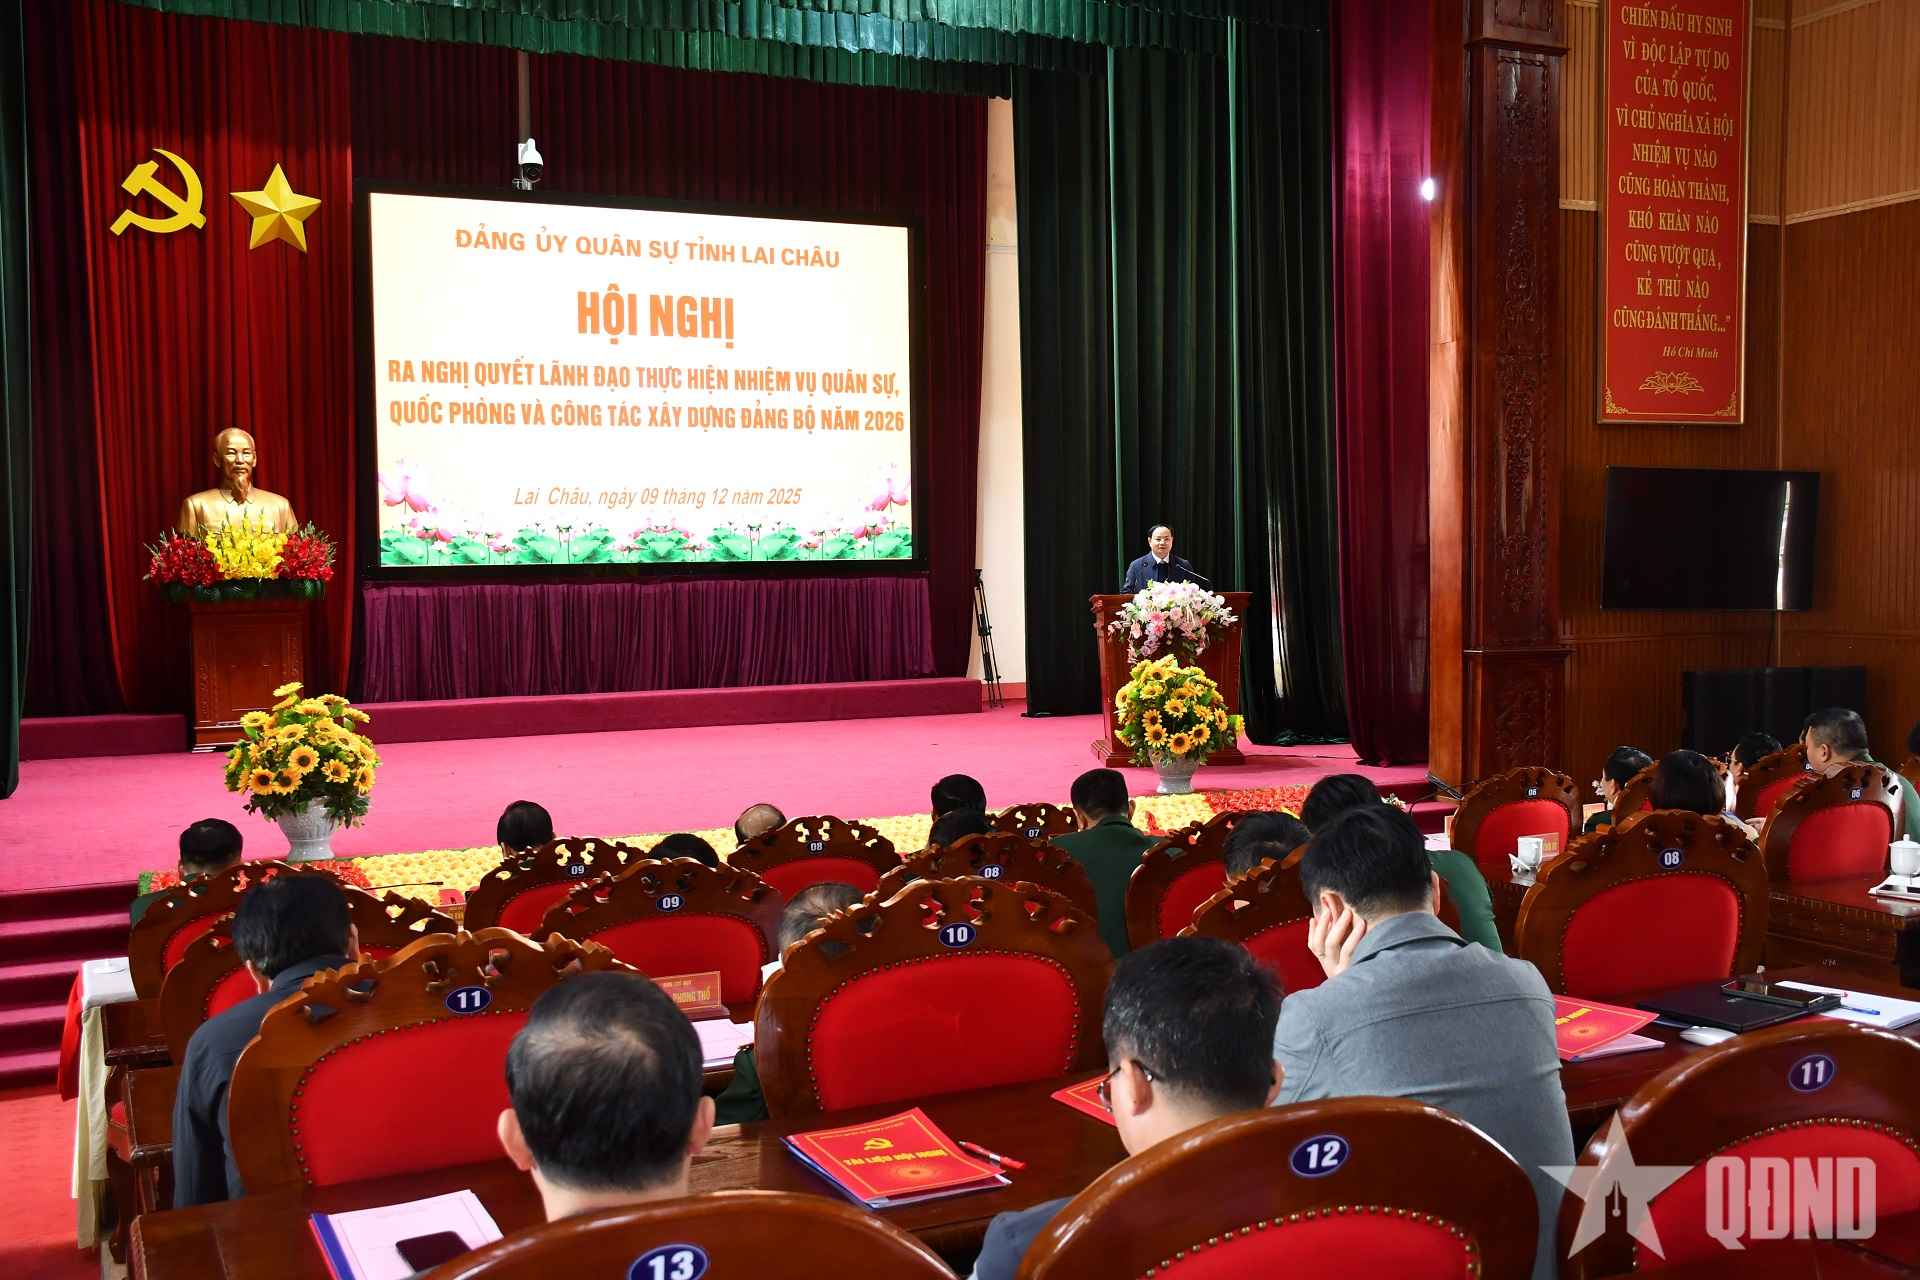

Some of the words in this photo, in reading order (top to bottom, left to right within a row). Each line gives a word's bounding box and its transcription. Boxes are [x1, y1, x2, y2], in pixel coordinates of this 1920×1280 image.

[1621, 1, 1658, 28] CHIẾN
[1660, 4, 1685, 31] ĐẤU
[1687, 14, 1703, 33] HY
[1705, 16, 1732, 37] SINH
[1623, 36, 1636, 60] VÌ
[1641, 38, 1666, 67] ĐỘC
[1669, 41, 1692, 69] LẬP
[1695, 48, 1711, 72] TỰ
[1713, 51, 1730, 70] DO
[1635, 69, 1659, 96] CỦA
[1663, 69, 1678, 98] TỔ
[1616, 103, 1628, 127] VÌ
[1631, 103, 1655, 129] CHỦ
[1657, 110, 1694, 133] NGHĨA
[1696, 112, 1711, 135] XÃ
[1713, 113, 1734, 142] HỘI
[1632, 139, 1671, 168] NHIỆM
[1675, 147, 1690, 171] VỤ
[1694, 144, 1717, 169] NÀO
[1618, 172, 1650, 196] CŨNG
[1653, 174, 1685, 198] HOÀN
[1688, 177, 1729, 206] THÀNH,
[1628, 205, 1653, 230] KHÓ
[1659, 208, 1690, 232] KHĂN
[1696, 210, 1719, 234] NÀO
[455, 222, 525, 251] ĐẢNG
[536, 226, 568, 253] ỦY
[576, 234, 641, 257] QUÂN
[649, 240, 680, 264] SỰ
[685, 236, 735, 262] TỈNH
[742, 246, 774, 264] LAI
[781, 246, 839, 268] CHÂU
[1625, 239, 1657, 263] CŨNG
[1659, 243, 1690, 269] VƯỢT
[1637, 270, 1652, 296] KẺ
[1658, 273, 1681, 297] THÙ
[1686, 275, 1710, 299] NÀO
[577, 283, 637, 345] HỘI
[650, 294, 734, 349] NGHỊ
[1613, 305, 1645, 328] CŨNG
[1647, 306, 1678, 330] ĐÁNH
[1678, 346, 1694, 358] Chí
[1695, 348, 1719, 359] Minh
[388, 360, 415, 382] RA
[421, 361, 468, 388] NGHỊ
[474, 356, 534, 387] QUYẾT
[540, 360, 588, 386] LÃNH
[594, 366, 630, 392] ĐẠO
[636, 366, 682, 393] THỰC
[688, 365, 728, 394] HIỆN
[734, 366, 790, 396] NHIỆM
[795, 372, 816, 397] VỤ
[821, 369, 867, 395] QUÂN
[872, 372, 899, 399] SỰ,
[390, 393, 442, 426] QUỐC
[449, 397, 515, 425] PHÒNG
[521, 399, 545, 425] VÀ
[551, 400, 602, 427] CÔNG
[608, 401, 641, 427] TÁC
[647, 402, 682, 427] XÂY
[688, 405, 736, 432] DỰNG
[741, 399, 788, 429] ĐẢNG
[794, 405, 815, 434] BỘ
[821, 406, 859, 430] NĂM
[865, 411, 904, 431] 2026
[514, 487, 540, 505] Lai
[548, 486, 592, 507] Châu,
[598, 487, 637, 509] ngày
[640, 487, 659, 505] 09
[663, 487, 706, 509] tháng
[712, 487, 727, 505] 12
[731, 489, 762, 505] năm
[766, 487, 802, 505] 2025
[1528, 788, 1537, 796] 06
[1851, 789, 1860, 798] 06
[810, 842, 823, 852] 08
[1029, 828, 1040, 838] 07
[571, 865, 585, 876] 09
[984, 867, 999, 878] 08
[1664, 851, 1680, 865] 08
[662, 896, 680, 910] 09
[946, 926, 968, 943] 10
[457, 989, 481, 1009] 11
[1801, 1060, 1824, 1085] 11
[1307, 1140, 1341, 1169] 12
[648, 1250, 694, 1280] 13
